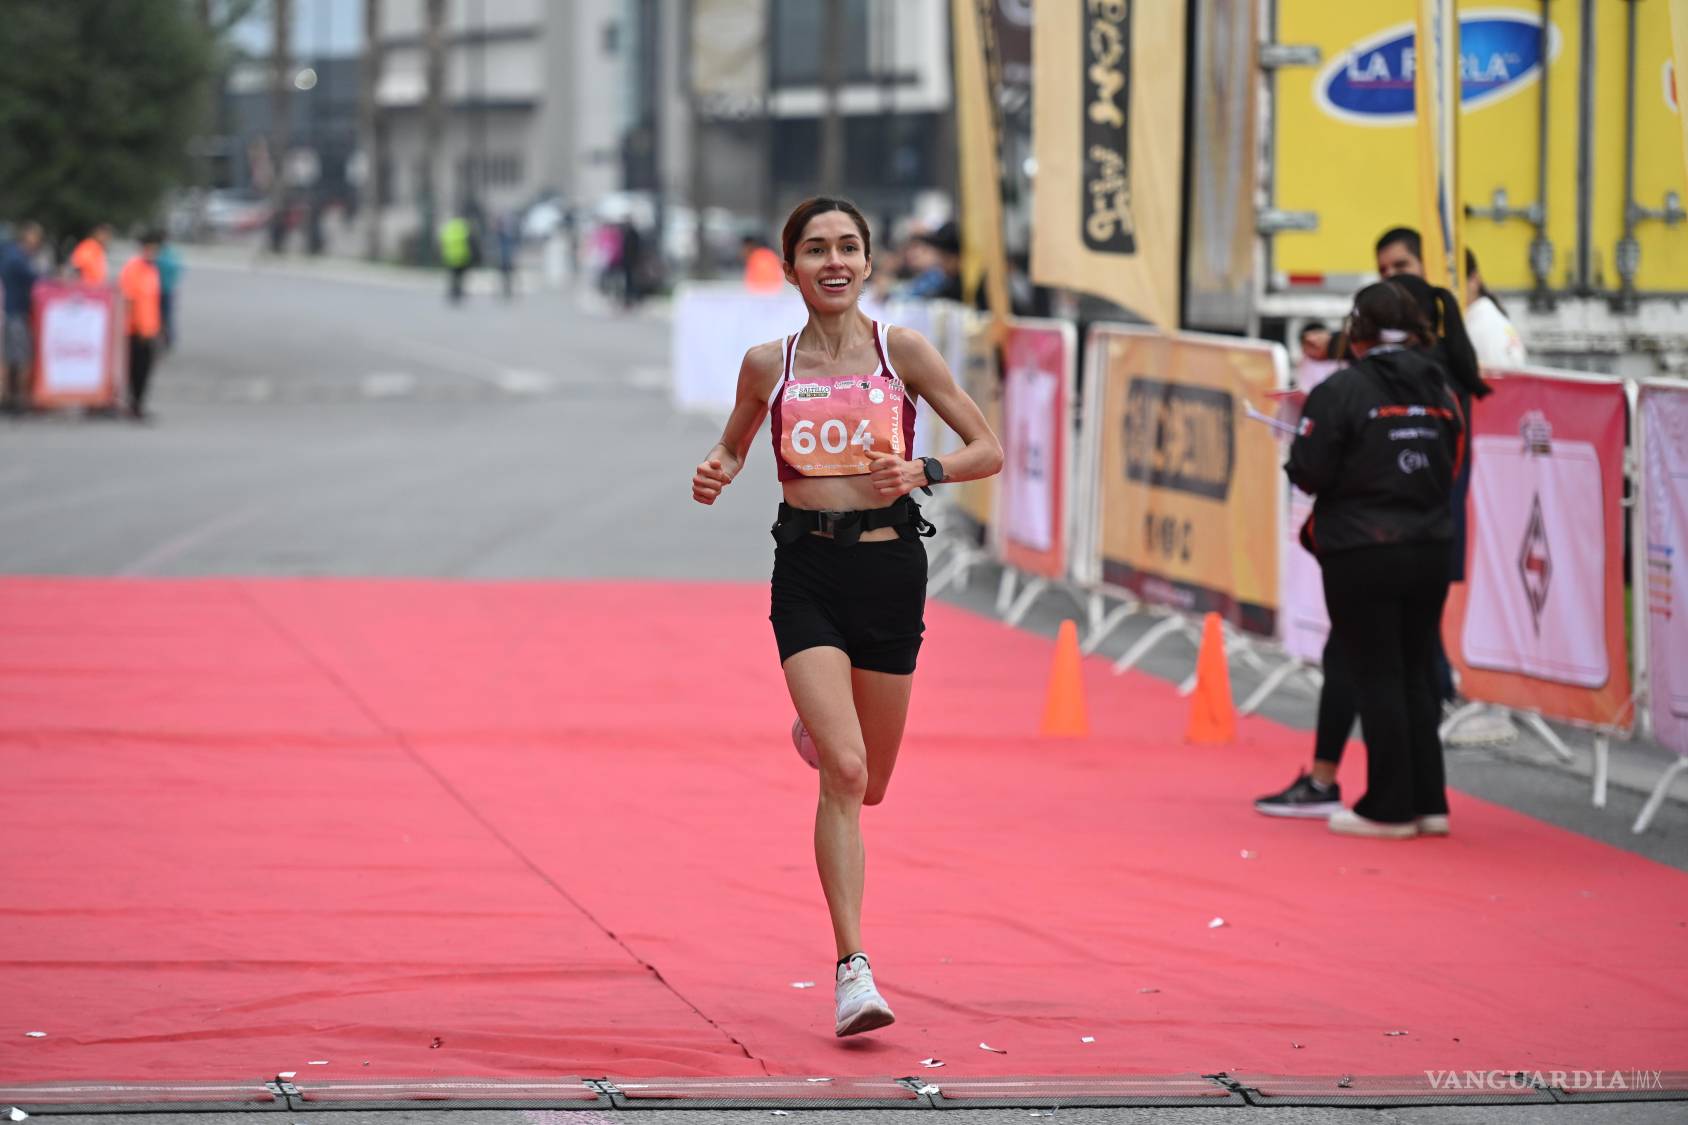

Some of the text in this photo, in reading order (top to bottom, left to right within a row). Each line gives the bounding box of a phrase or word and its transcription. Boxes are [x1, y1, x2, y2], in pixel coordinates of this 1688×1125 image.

[1347, 51, 1391, 82] LA
[889, 393, 901, 402] 604
[791, 419, 874, 454] 604
[891, 406, 900, 454] EDALLA
